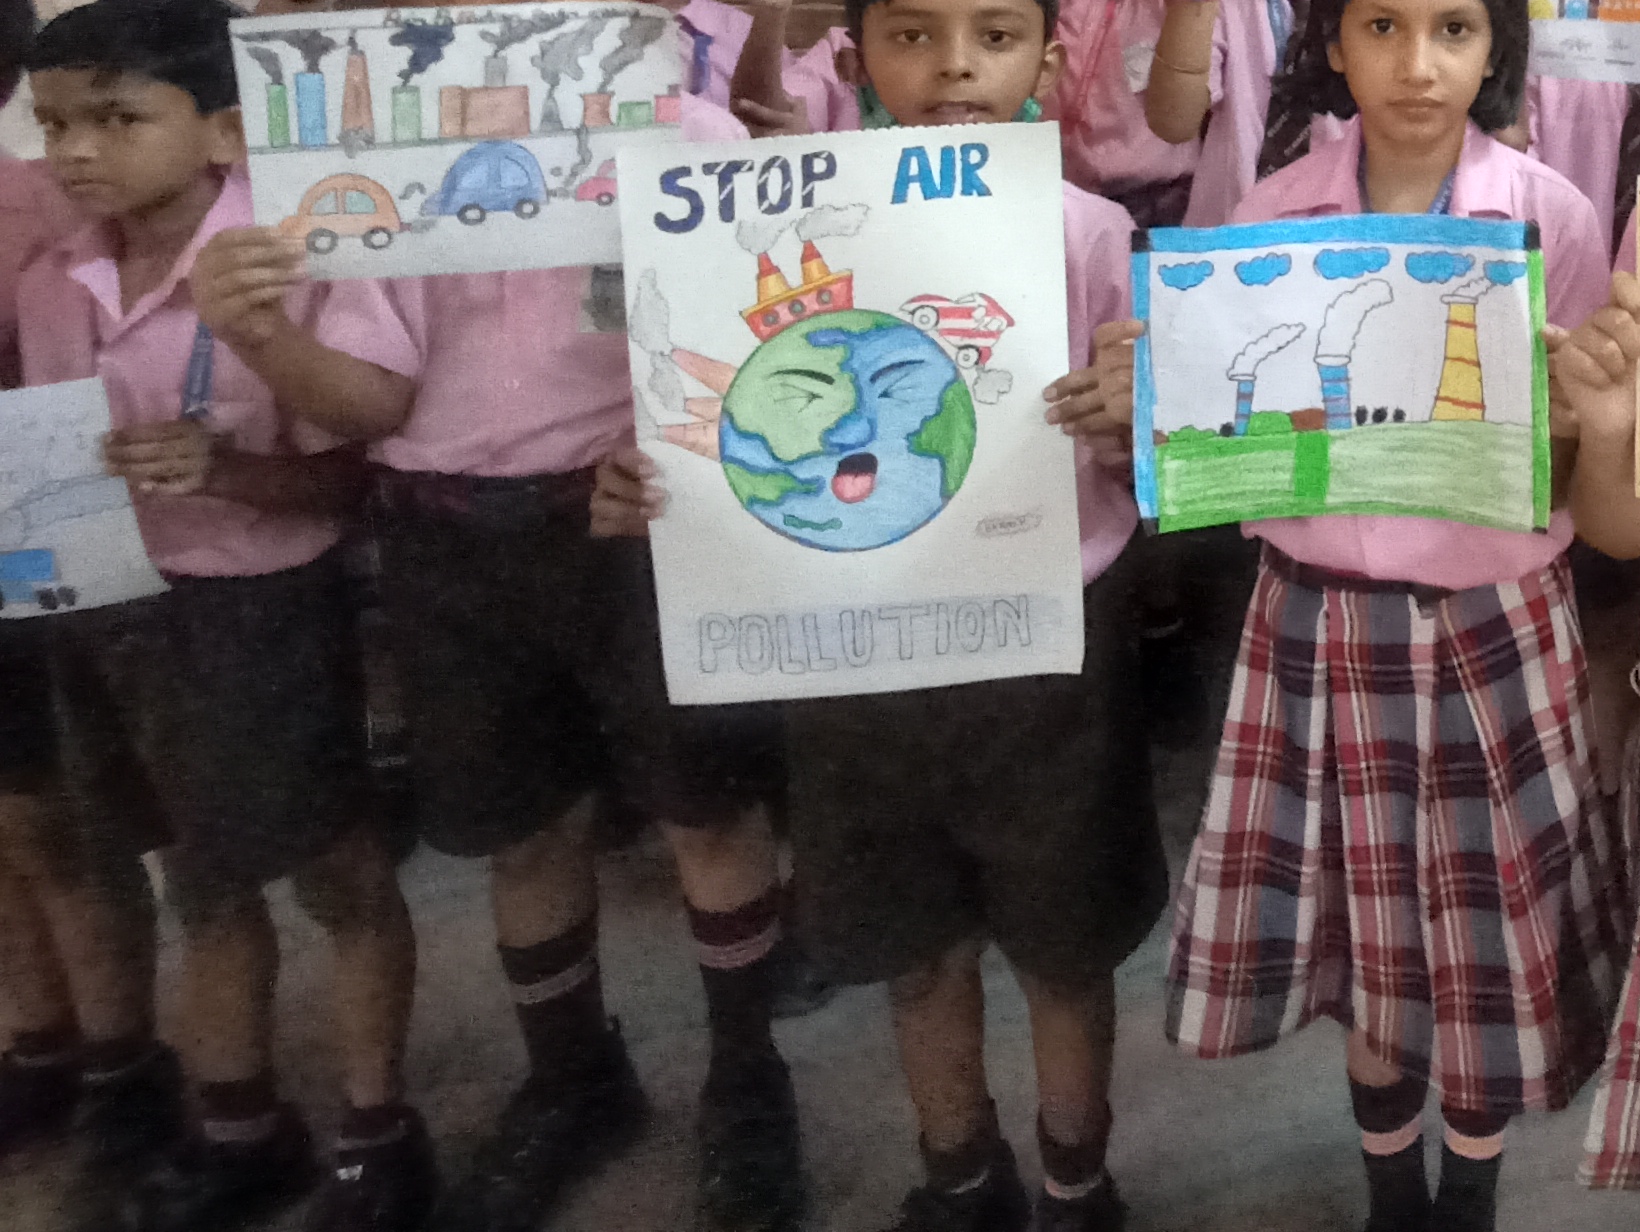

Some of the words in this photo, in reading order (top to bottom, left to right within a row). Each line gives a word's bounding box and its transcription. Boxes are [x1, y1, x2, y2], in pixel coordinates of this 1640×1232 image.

[653, 149, 839, 234] STOP
[890, 142, 994, 206] AIR
[699, 593, 1033, 676] POLLUTION
